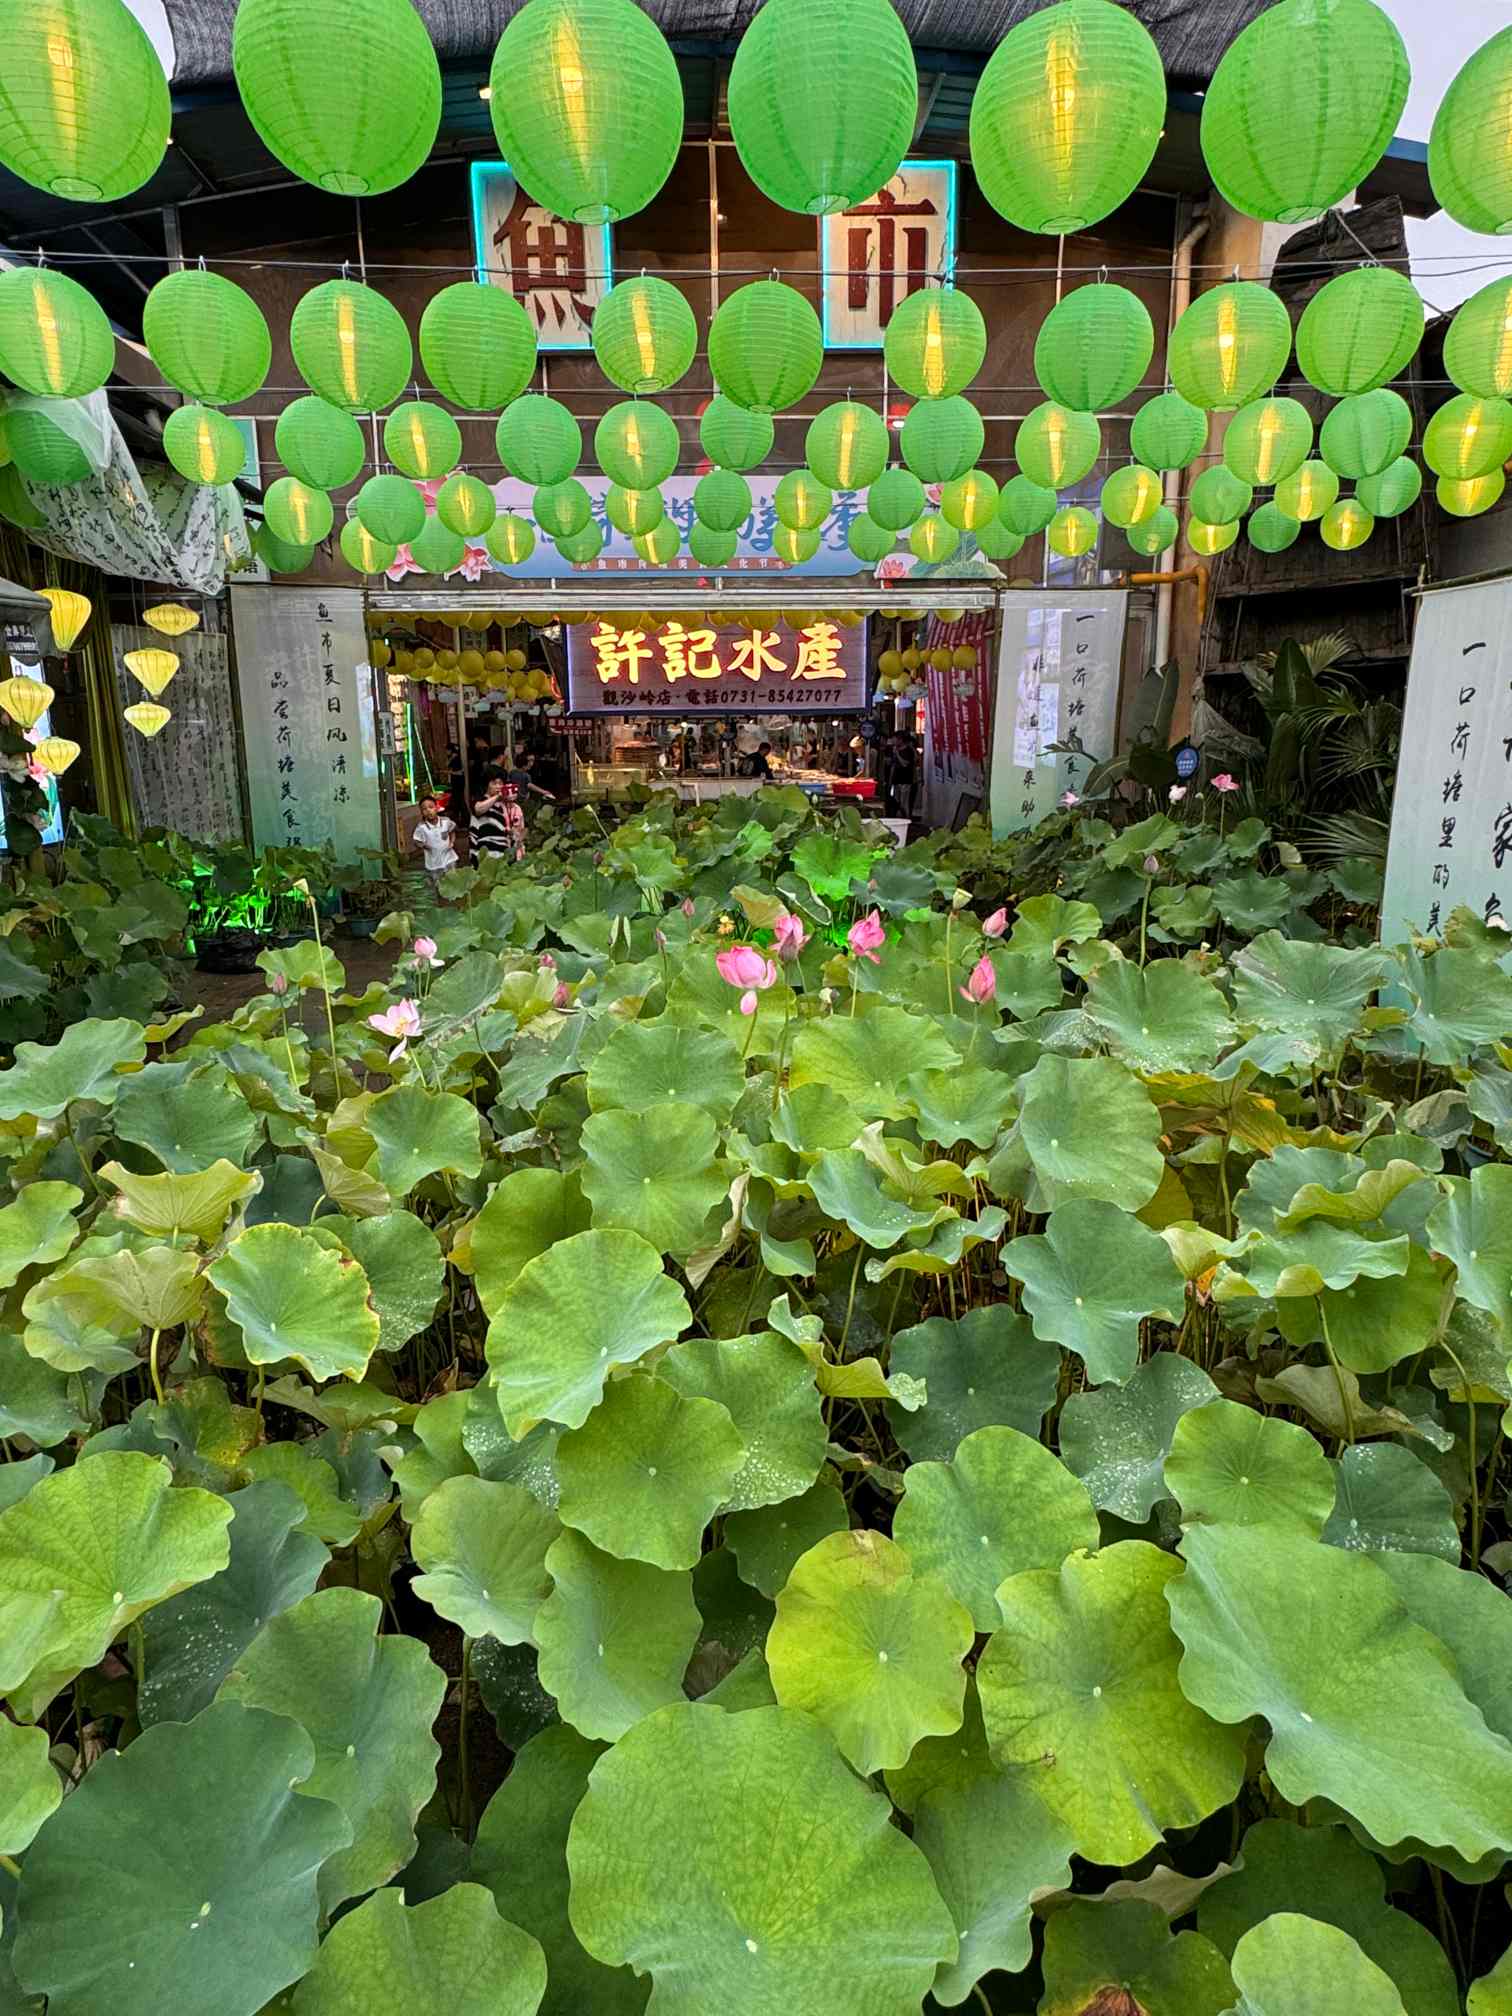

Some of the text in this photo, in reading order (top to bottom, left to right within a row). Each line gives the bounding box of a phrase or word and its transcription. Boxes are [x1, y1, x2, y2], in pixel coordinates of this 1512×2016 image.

[842, 189, 938, 328] 市
[590, 621, 847, 684] 許記水產
[1061, 613, 1096, 796] 一口荷塘美食
